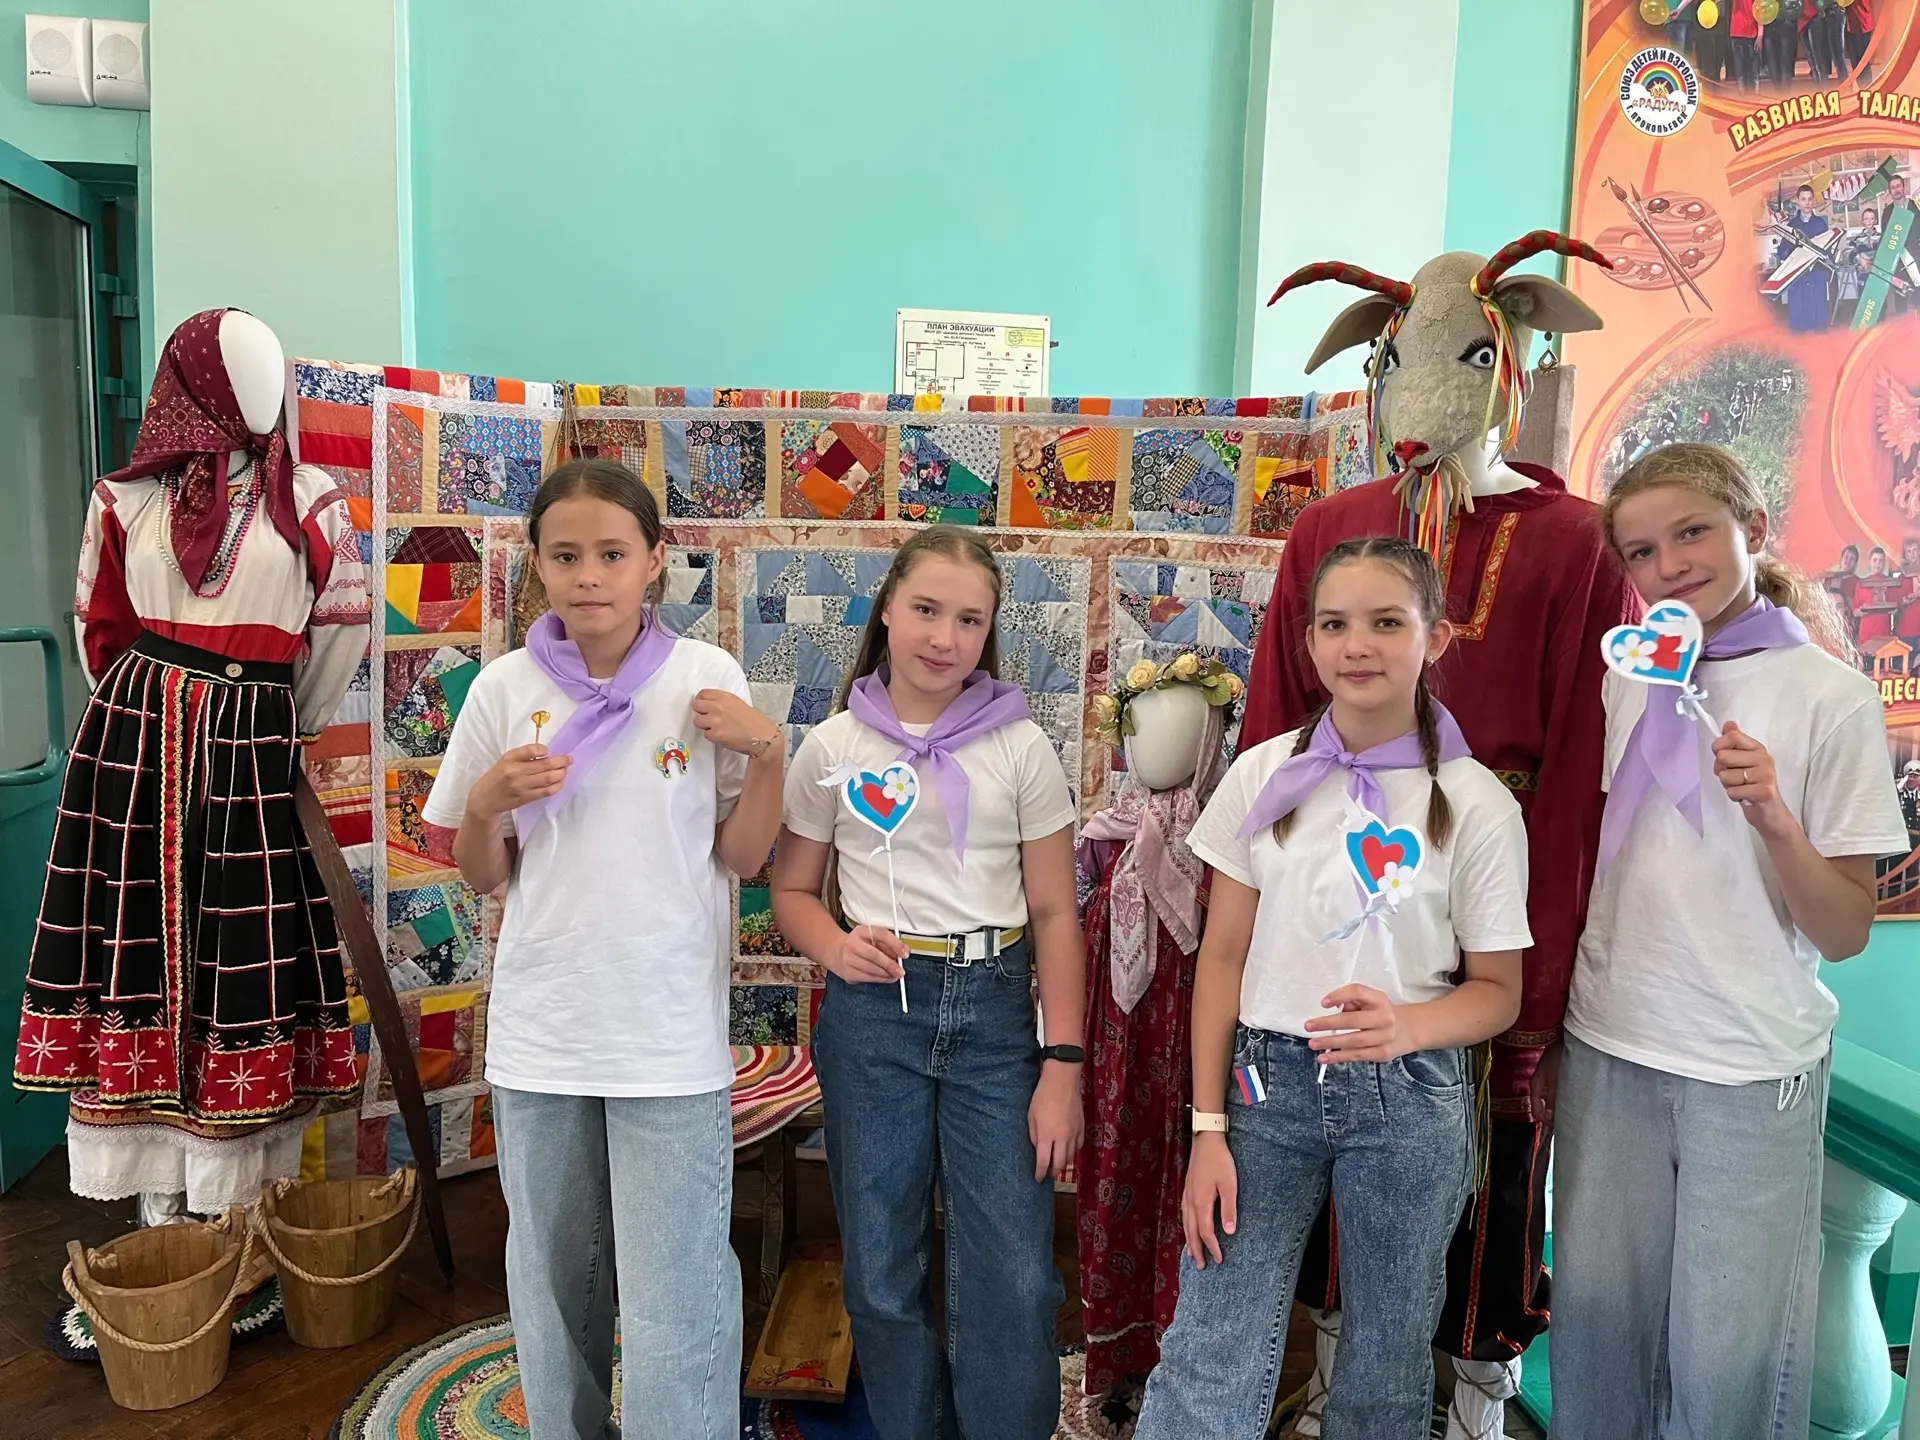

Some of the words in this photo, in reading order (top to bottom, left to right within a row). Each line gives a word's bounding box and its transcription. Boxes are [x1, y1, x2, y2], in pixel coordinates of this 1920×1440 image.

[1620, 68, 1636, 101] СОЮЗ
[1631, 48, 1659, 72] ДЕТЕЙ
[1630, 111, 1688, 134] ПРОКОПЬЕВСК
[1730, 90, 1841, 150] РАЗВИВАЯ
[927, 323, 948, 331] ПЛАН
[949, 324, 995, 333] ЭВАКУАЦИИ
